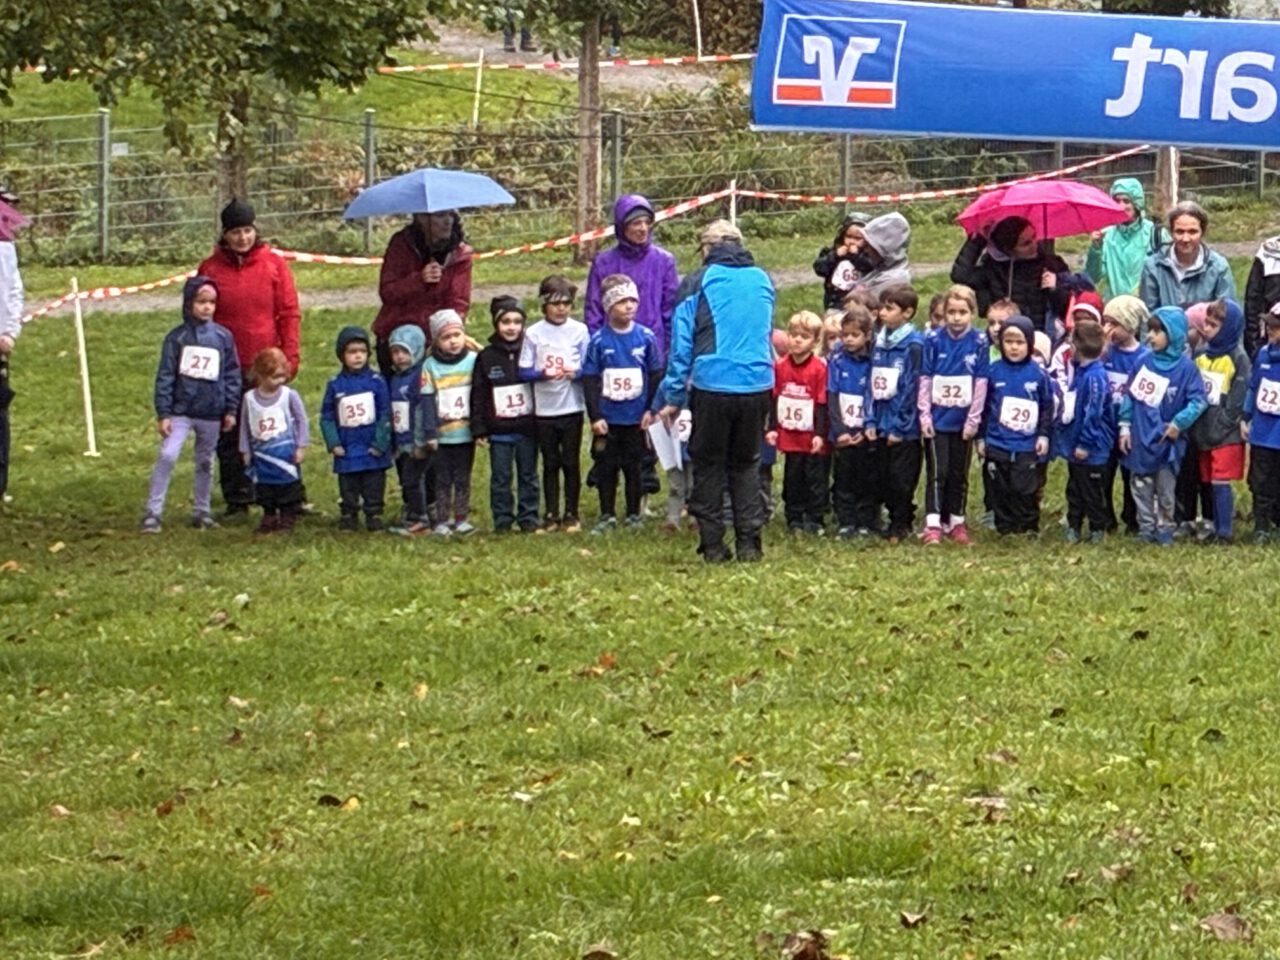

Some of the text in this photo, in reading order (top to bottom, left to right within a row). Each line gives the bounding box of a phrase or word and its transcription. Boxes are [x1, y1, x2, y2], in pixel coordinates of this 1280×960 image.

[190, 355, 211, 370] 27
[545, 355, 564, 370] 59
[613, 377, 633, 391] 58
[874, 376, 888, 391] 63
[942, 384, 962, 398] 32
[1138, 377, 1156, 395] 69
[454, 396, 464, 409] 4
[506, 393, 525, 408] 13
[1262, 388, 1279, 405] 22
[346, 403, 366, 419] 35
[784, 407, 802, 421] 16
[845, 404, 864, 419] 41
[1012, 408, 1031, 423] 29
[258, 417, 276, 433] 62
